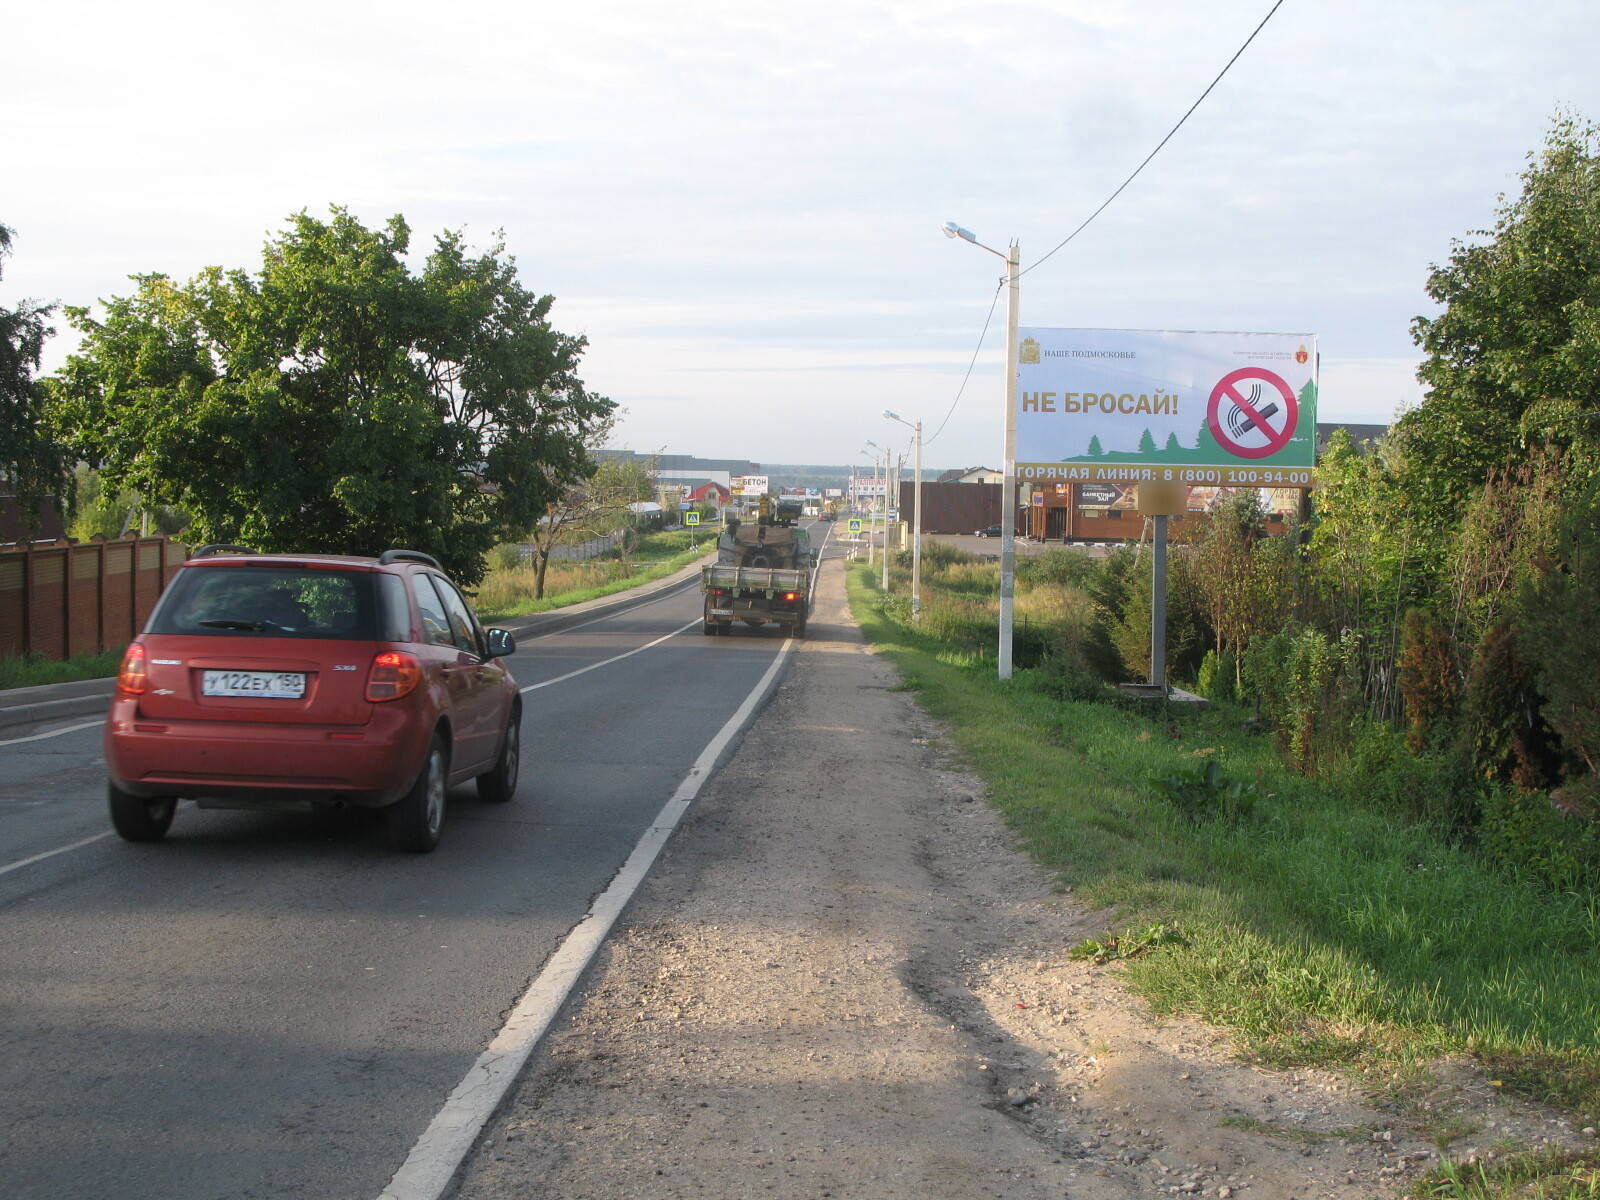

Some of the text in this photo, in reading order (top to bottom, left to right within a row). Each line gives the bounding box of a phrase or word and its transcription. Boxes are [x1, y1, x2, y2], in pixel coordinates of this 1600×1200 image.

[1044, 350, 1136, 359] НАШЕ ПОДМОСКОВЬЕ
[1022, 389, 1179, 415] НЕ БРОСАЙ!
[1016, 466, 1309, 484] ГОРЯЧАЯ ЛИНИЯ: 8 (800) 100-94-00
[742, 478, 767, 486] БЕТОН
